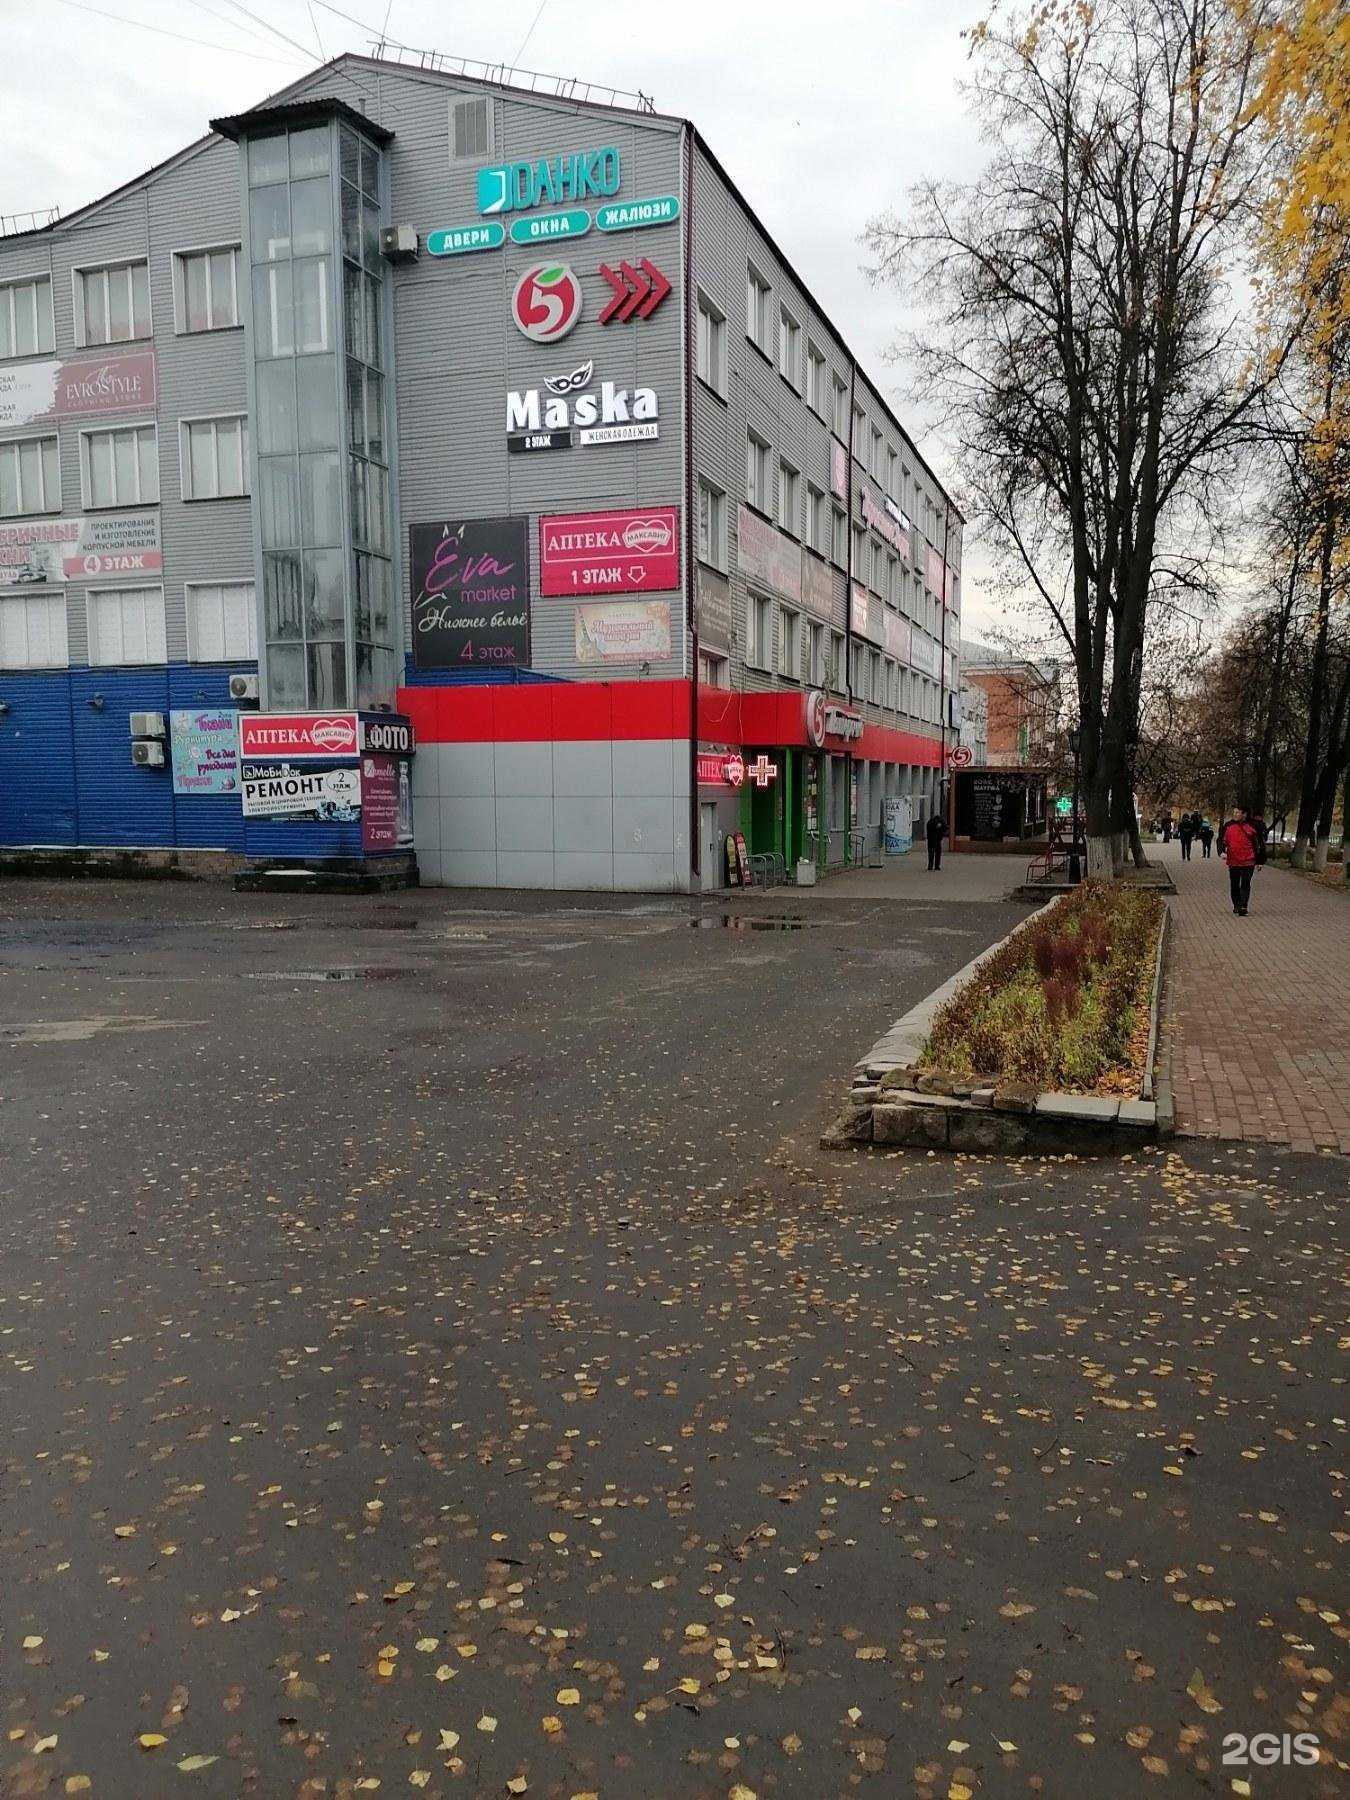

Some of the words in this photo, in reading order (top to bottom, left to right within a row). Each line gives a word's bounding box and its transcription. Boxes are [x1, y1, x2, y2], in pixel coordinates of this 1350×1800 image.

[605, 201, 671, 225] ЖАЛЮЗИ
[531, 215, 570, 236] ОКНА
[443, 228, 490, 250] ДВЕРИ
[507, 381, 659, 432] Maska
[525, 437, 531, 448] 2
[587, 429, 622, 441] ЖЕНСКАЯ
[622, 426, 656, 438] ОДЕЖДА
[91, 518, 155, 530] ПРОЕКТИРОВАНИЕ
[101, 529, 156, 540] ИЗГОТОВЛЕНИЕ
[547, 531, 621, 551] АПТЕКА
[83, 541, 125, 551] КОРПУСНОЙ
[126, 539, 157, 549] МЕБЕЛИ
[104, 555, 145, 570] ЭТАЖ
[425, 536, 514, 592] Eva
[571, 570, 578, 584] 1
[582, 567, 623, 584] ЭТАЖ
[461, 584, 517, 602] market
[460, 640, 473, 660] 4
[479, 645, 516, 659] этаж
[246, 729, 312, 744] АПТЕКА
[371, 724, 408, 750] ФОТО
[338, 773, 345, 783] 2
[245, 777, 324, 799] РЕМОНТ
